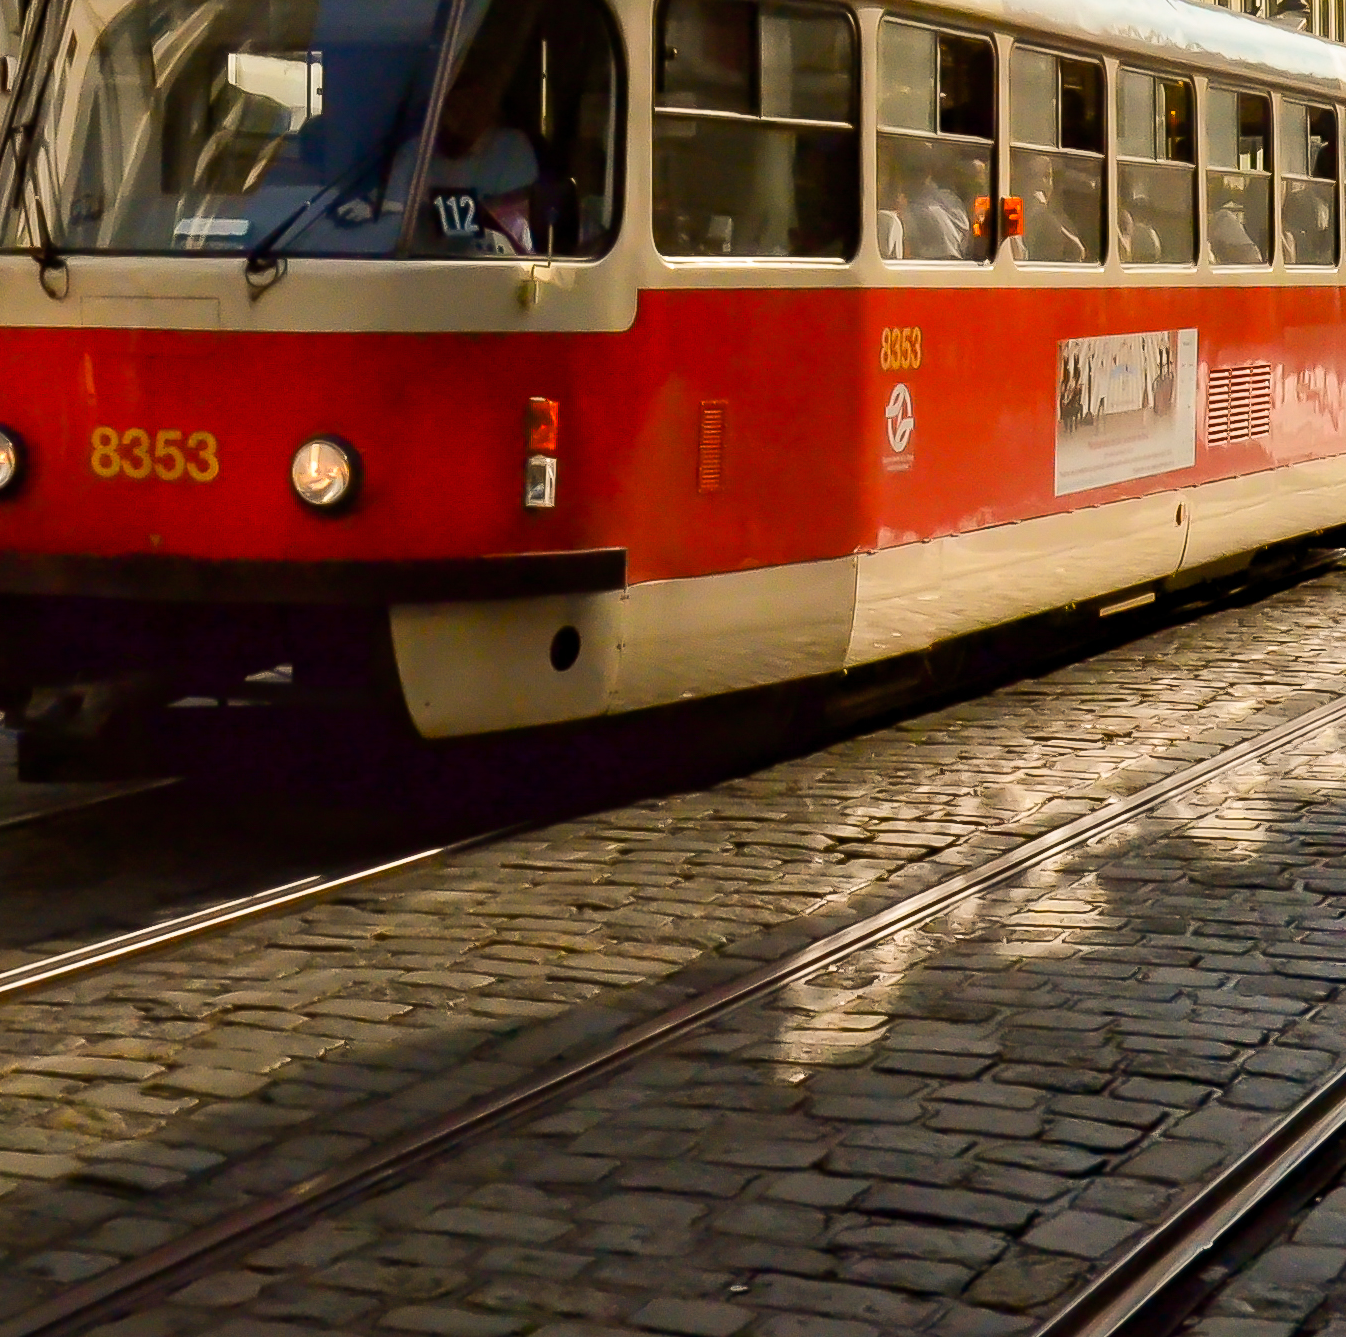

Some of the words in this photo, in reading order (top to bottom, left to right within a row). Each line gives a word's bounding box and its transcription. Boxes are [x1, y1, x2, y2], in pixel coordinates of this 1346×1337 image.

[434, 195, 480, 235] 112
[880, 326, 922, 370] 8353
[91, 426, 220, 482] 8353
